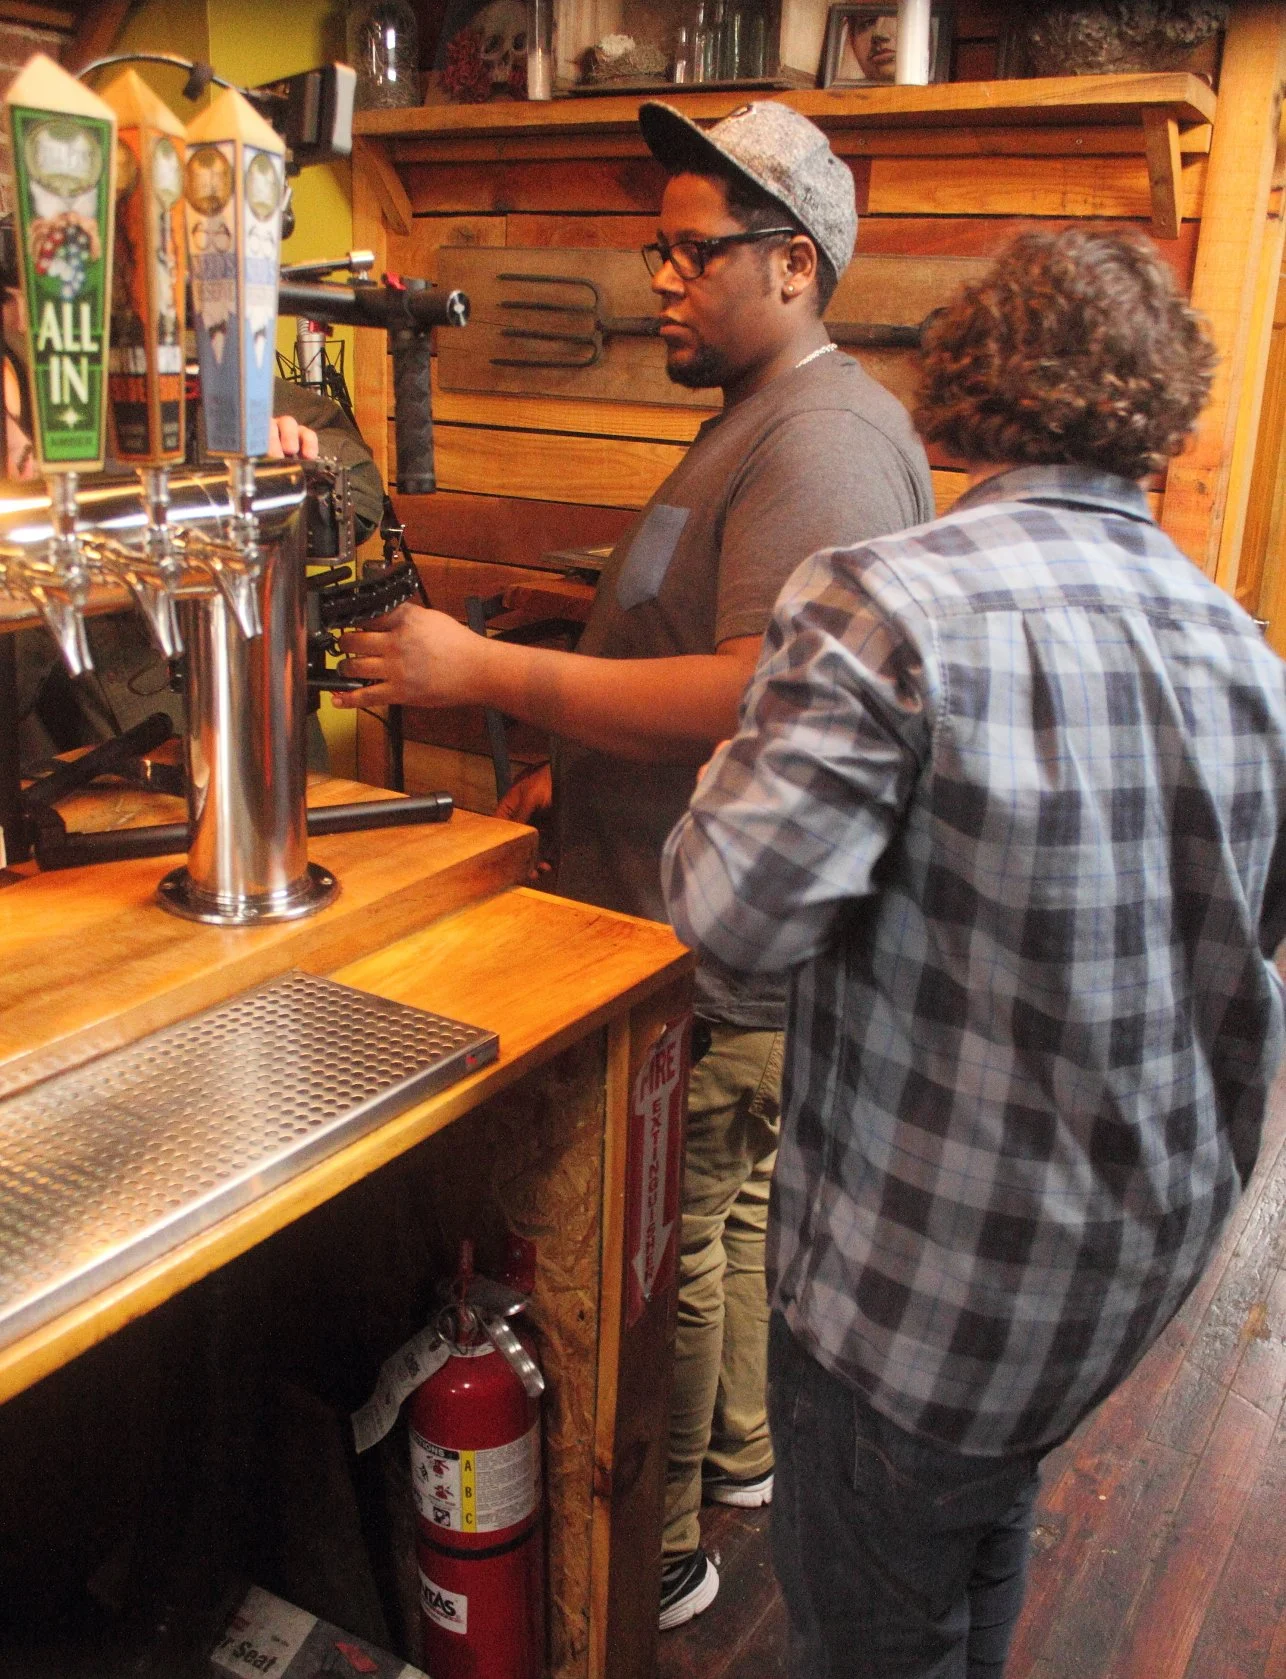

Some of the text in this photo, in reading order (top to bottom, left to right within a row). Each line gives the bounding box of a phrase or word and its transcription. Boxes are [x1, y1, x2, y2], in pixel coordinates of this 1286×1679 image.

[37, 303, 100, 353] ALL
[48, 355, 90, 405] IN
[640, 1041, 676, 1103] FIRE
[645, 1100, 661, 1281] EXTINGUISHER
[464, 1460, 472, 1472] A
[465, 1486, 472, 1498] B
[465, 1513, 473, 1525] C
[232, 1640, 278, 1673] Seat
